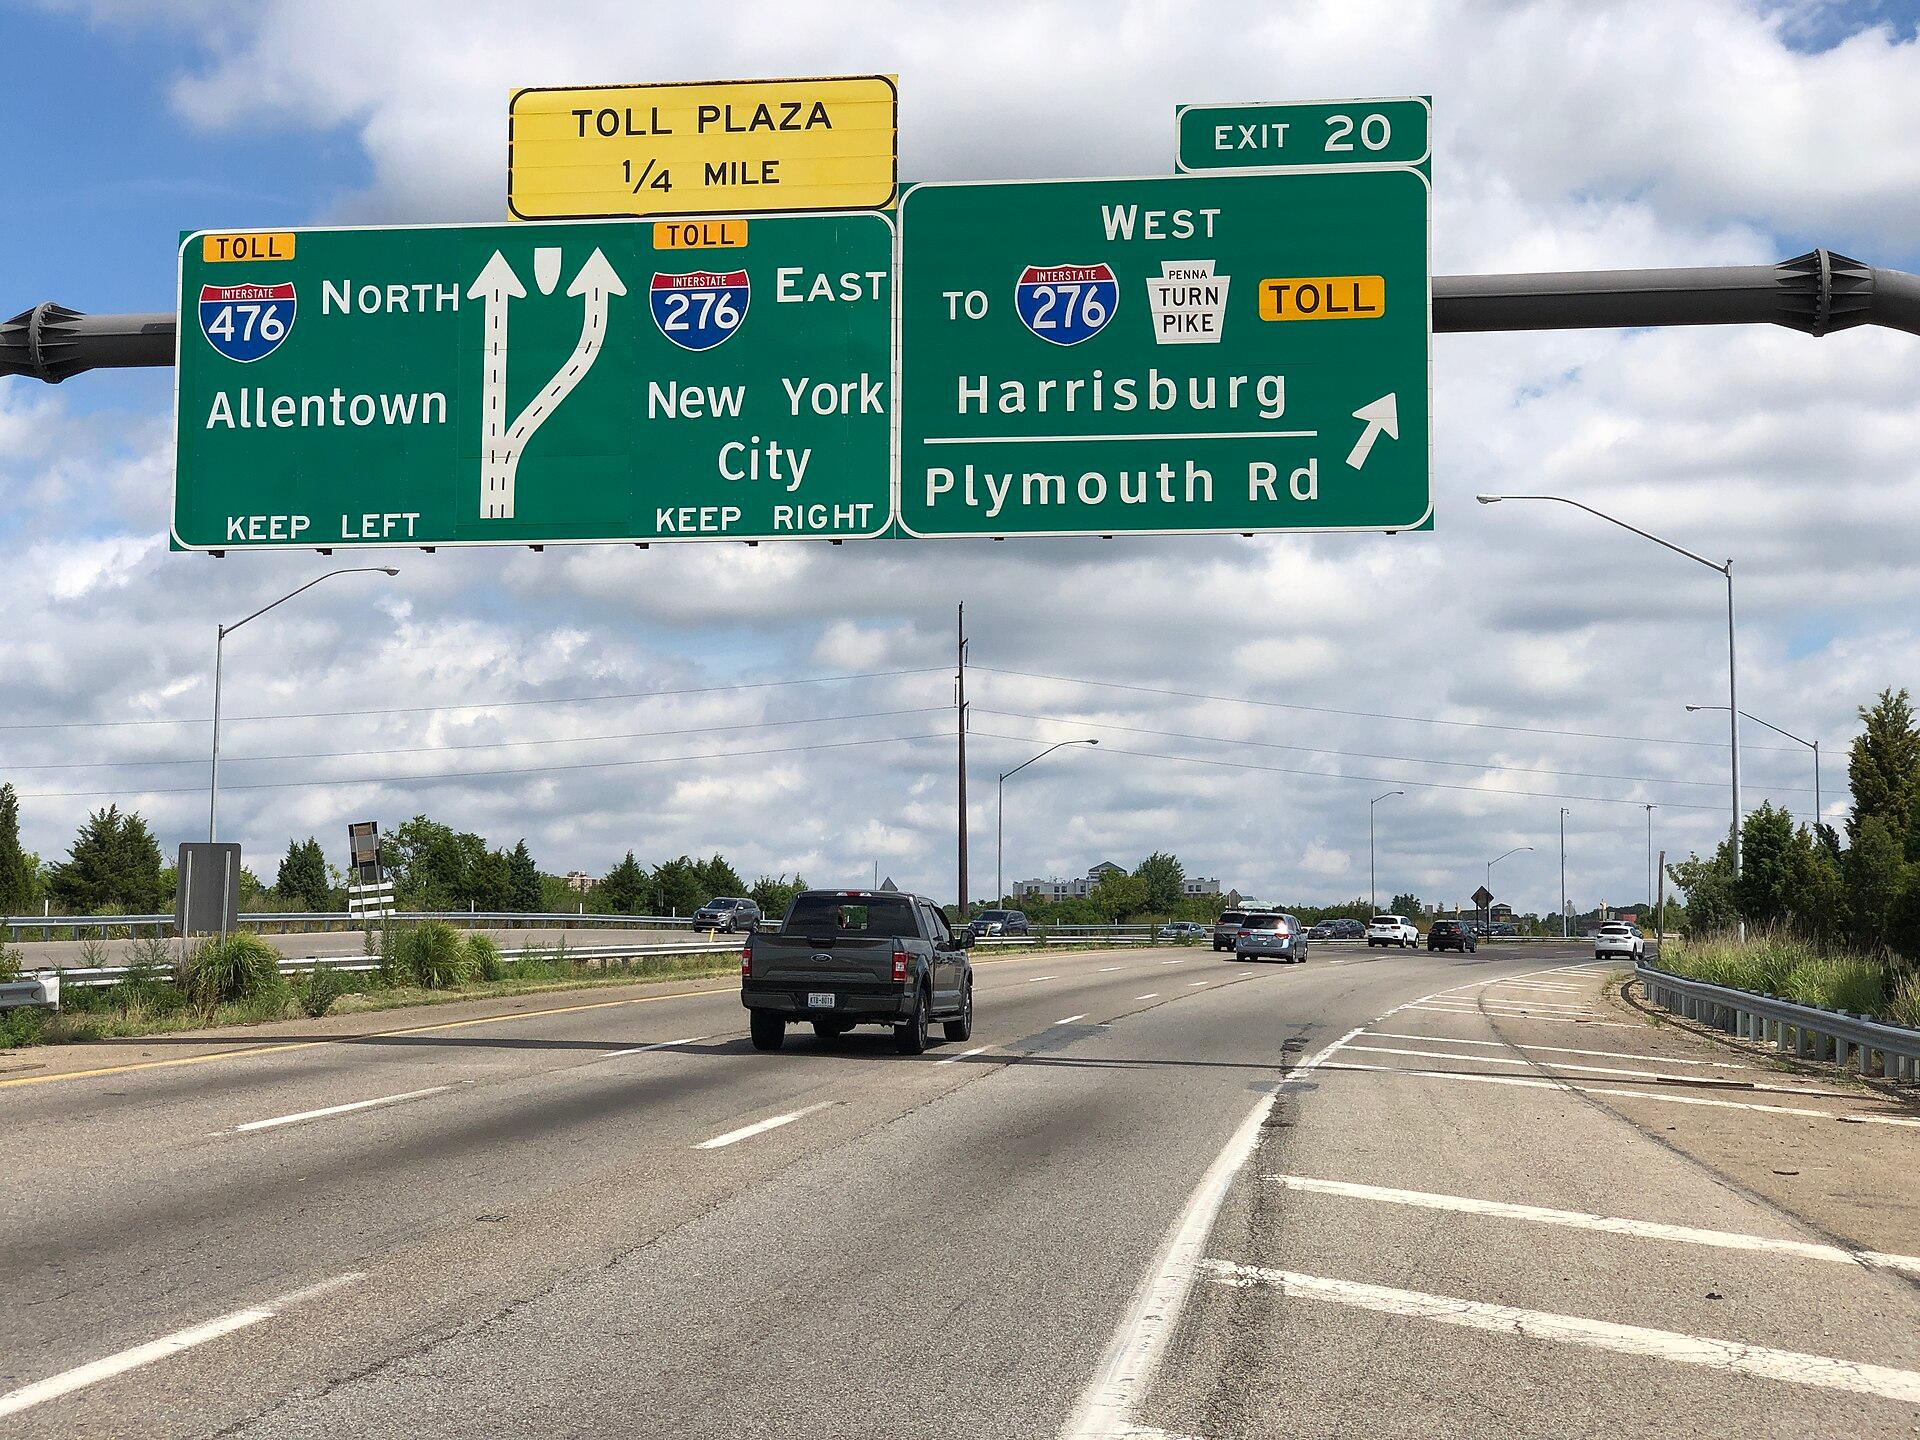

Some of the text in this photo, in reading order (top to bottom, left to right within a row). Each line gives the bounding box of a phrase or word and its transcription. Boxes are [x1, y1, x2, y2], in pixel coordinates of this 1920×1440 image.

[571, 101, 833, 138] TOLL PLAZA
[1215, 113, 1391, 152] EXIT 20
[622, 158, 780, 194] 1/4 MILE
[666, 224, 735, 246] TOLL
[1101, 204, 1221, 241] WEST
[216, 236, 283, 259] TOLL
[672, 276, 726, 287] INTERSTATE
[777, 267, 888, 302] EAST
[1036, 270, 1097, 281] INTERSTATE
[1168, 269, 1208, 280] PENNA
[221, 288, 274, 299] INTERSTATE
[322, 279, 459, 315] NORTH
[942, 290, 989, 320] TO
[1032, 286, 1106, 329] 276
[1158, 286, 1219, 307] TURN
[1268, 282, 1376, 314] TOLL
[208, 305, 286, 343] 476
[664, 293, 740, 330] 276
[1163, 313, 1214, 334] PIKE
[206, 387, 447, 429] Allentown
[648, 372, 884, 419] New York
[958, 368, 1285, 419] Harrisburg
[718, 435, 812, 492] City
[926, 458, 1318, 518] Plymouth Rd
[227, 512, 420, 541] KEEP LEFT
[656, 503, 874, 532] KEEP RIGHT
